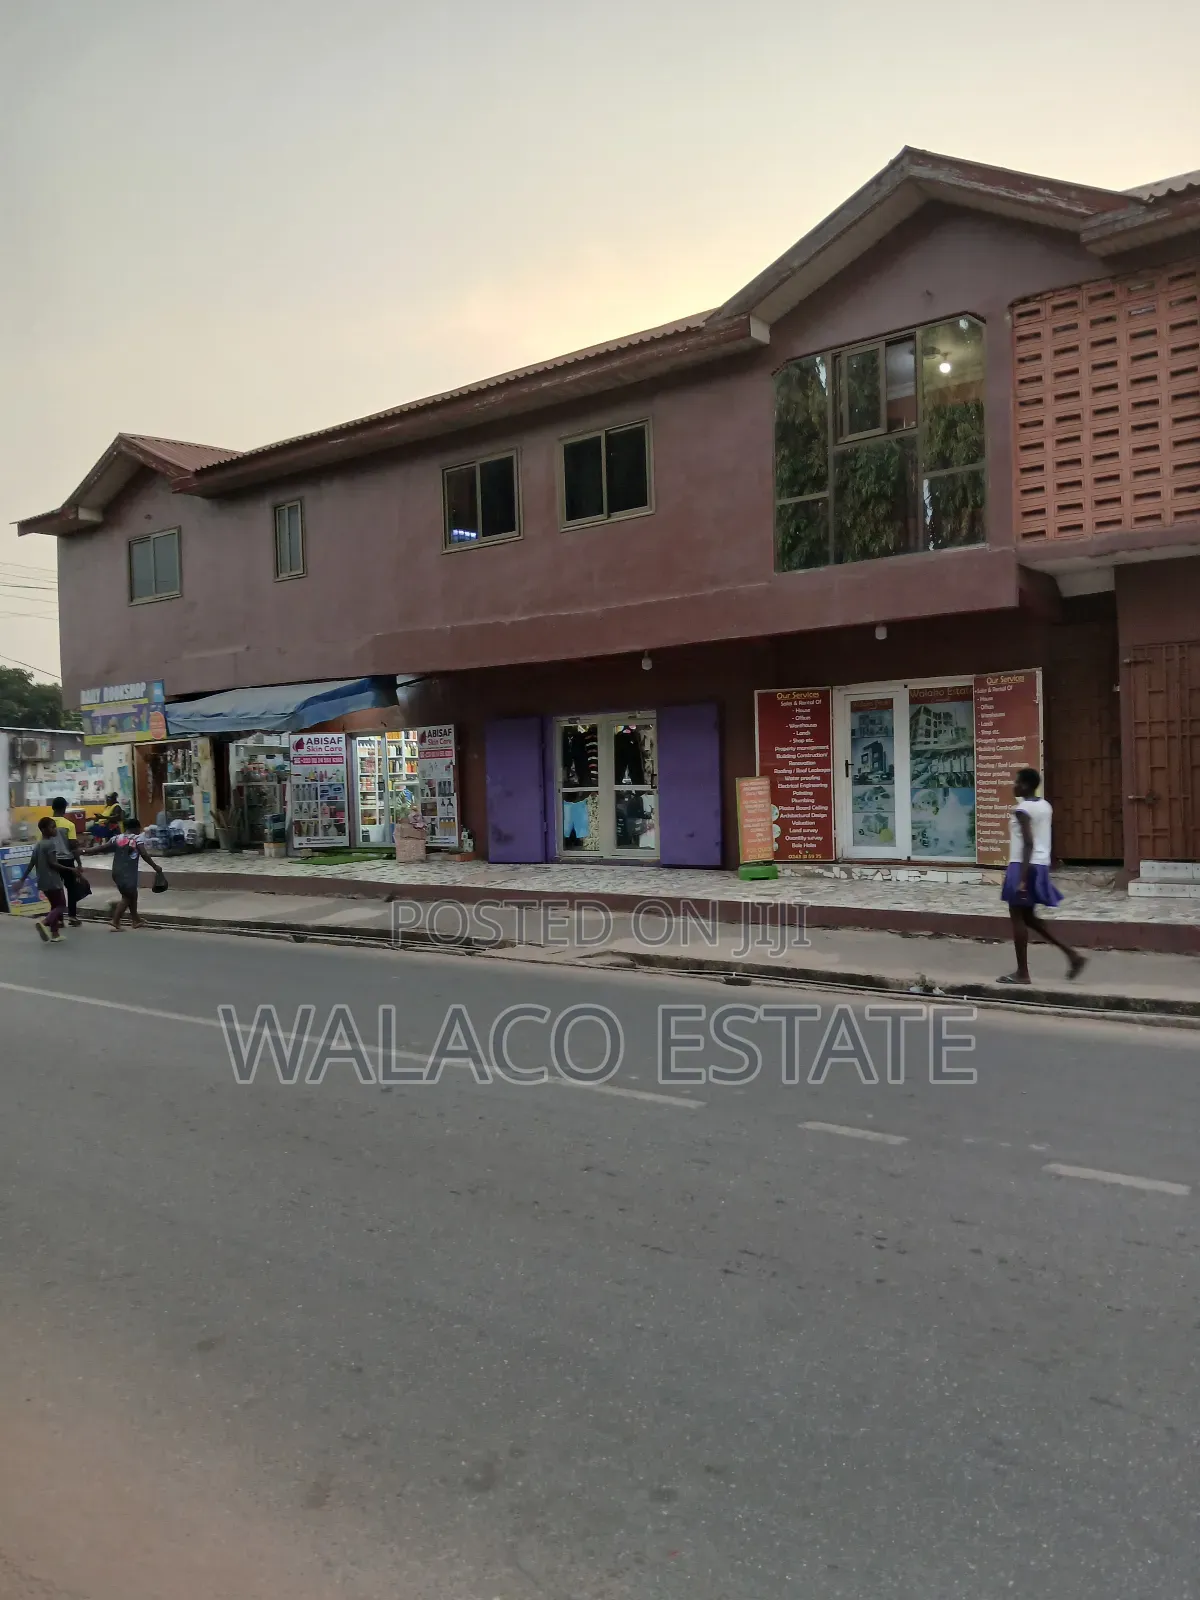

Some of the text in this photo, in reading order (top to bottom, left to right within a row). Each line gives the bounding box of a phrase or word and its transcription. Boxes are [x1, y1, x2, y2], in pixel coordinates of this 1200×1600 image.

[776, 691, 820, 700] Our Services
[427, 728, 452, 738] ABISAF
[305, 736, 343, 746] ABISAF
[306, 745, 323, 753] Skin
